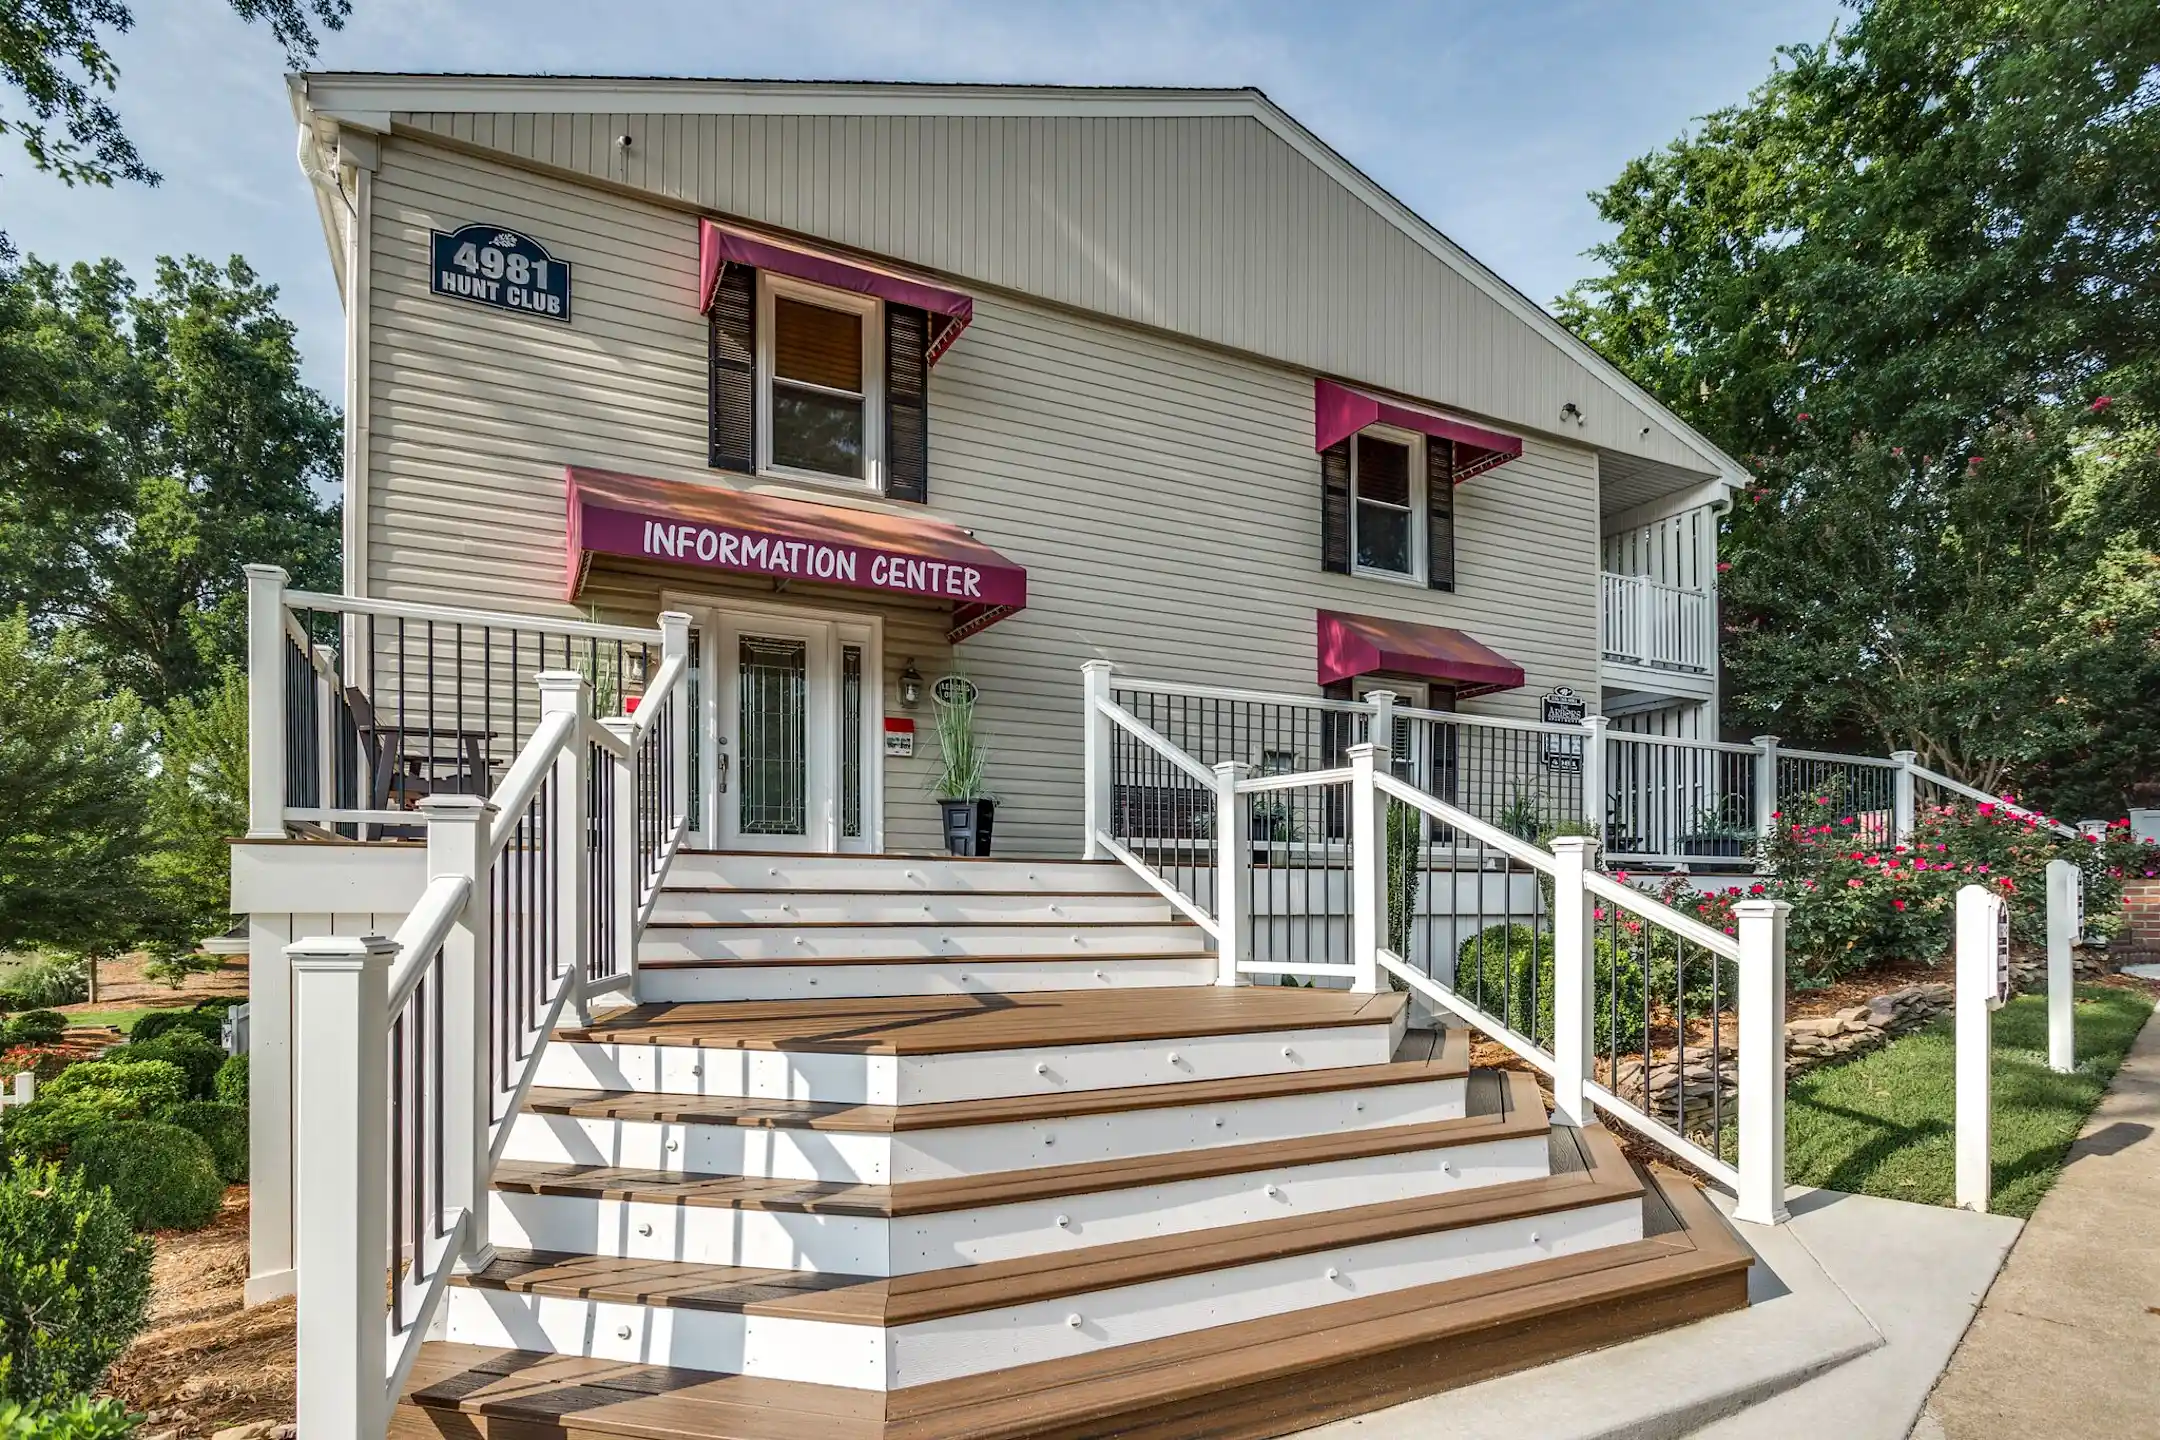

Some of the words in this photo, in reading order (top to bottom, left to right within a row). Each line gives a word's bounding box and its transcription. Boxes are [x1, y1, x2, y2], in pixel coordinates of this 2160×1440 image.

[453, 241, 548, 290] 4981
[441, 270, 500, 302] HUNT
[506, 286, 561, 315] CLUB
[642, 519, 857, 582] INFORMATION
[871, 554, 982, 598] CENTER
